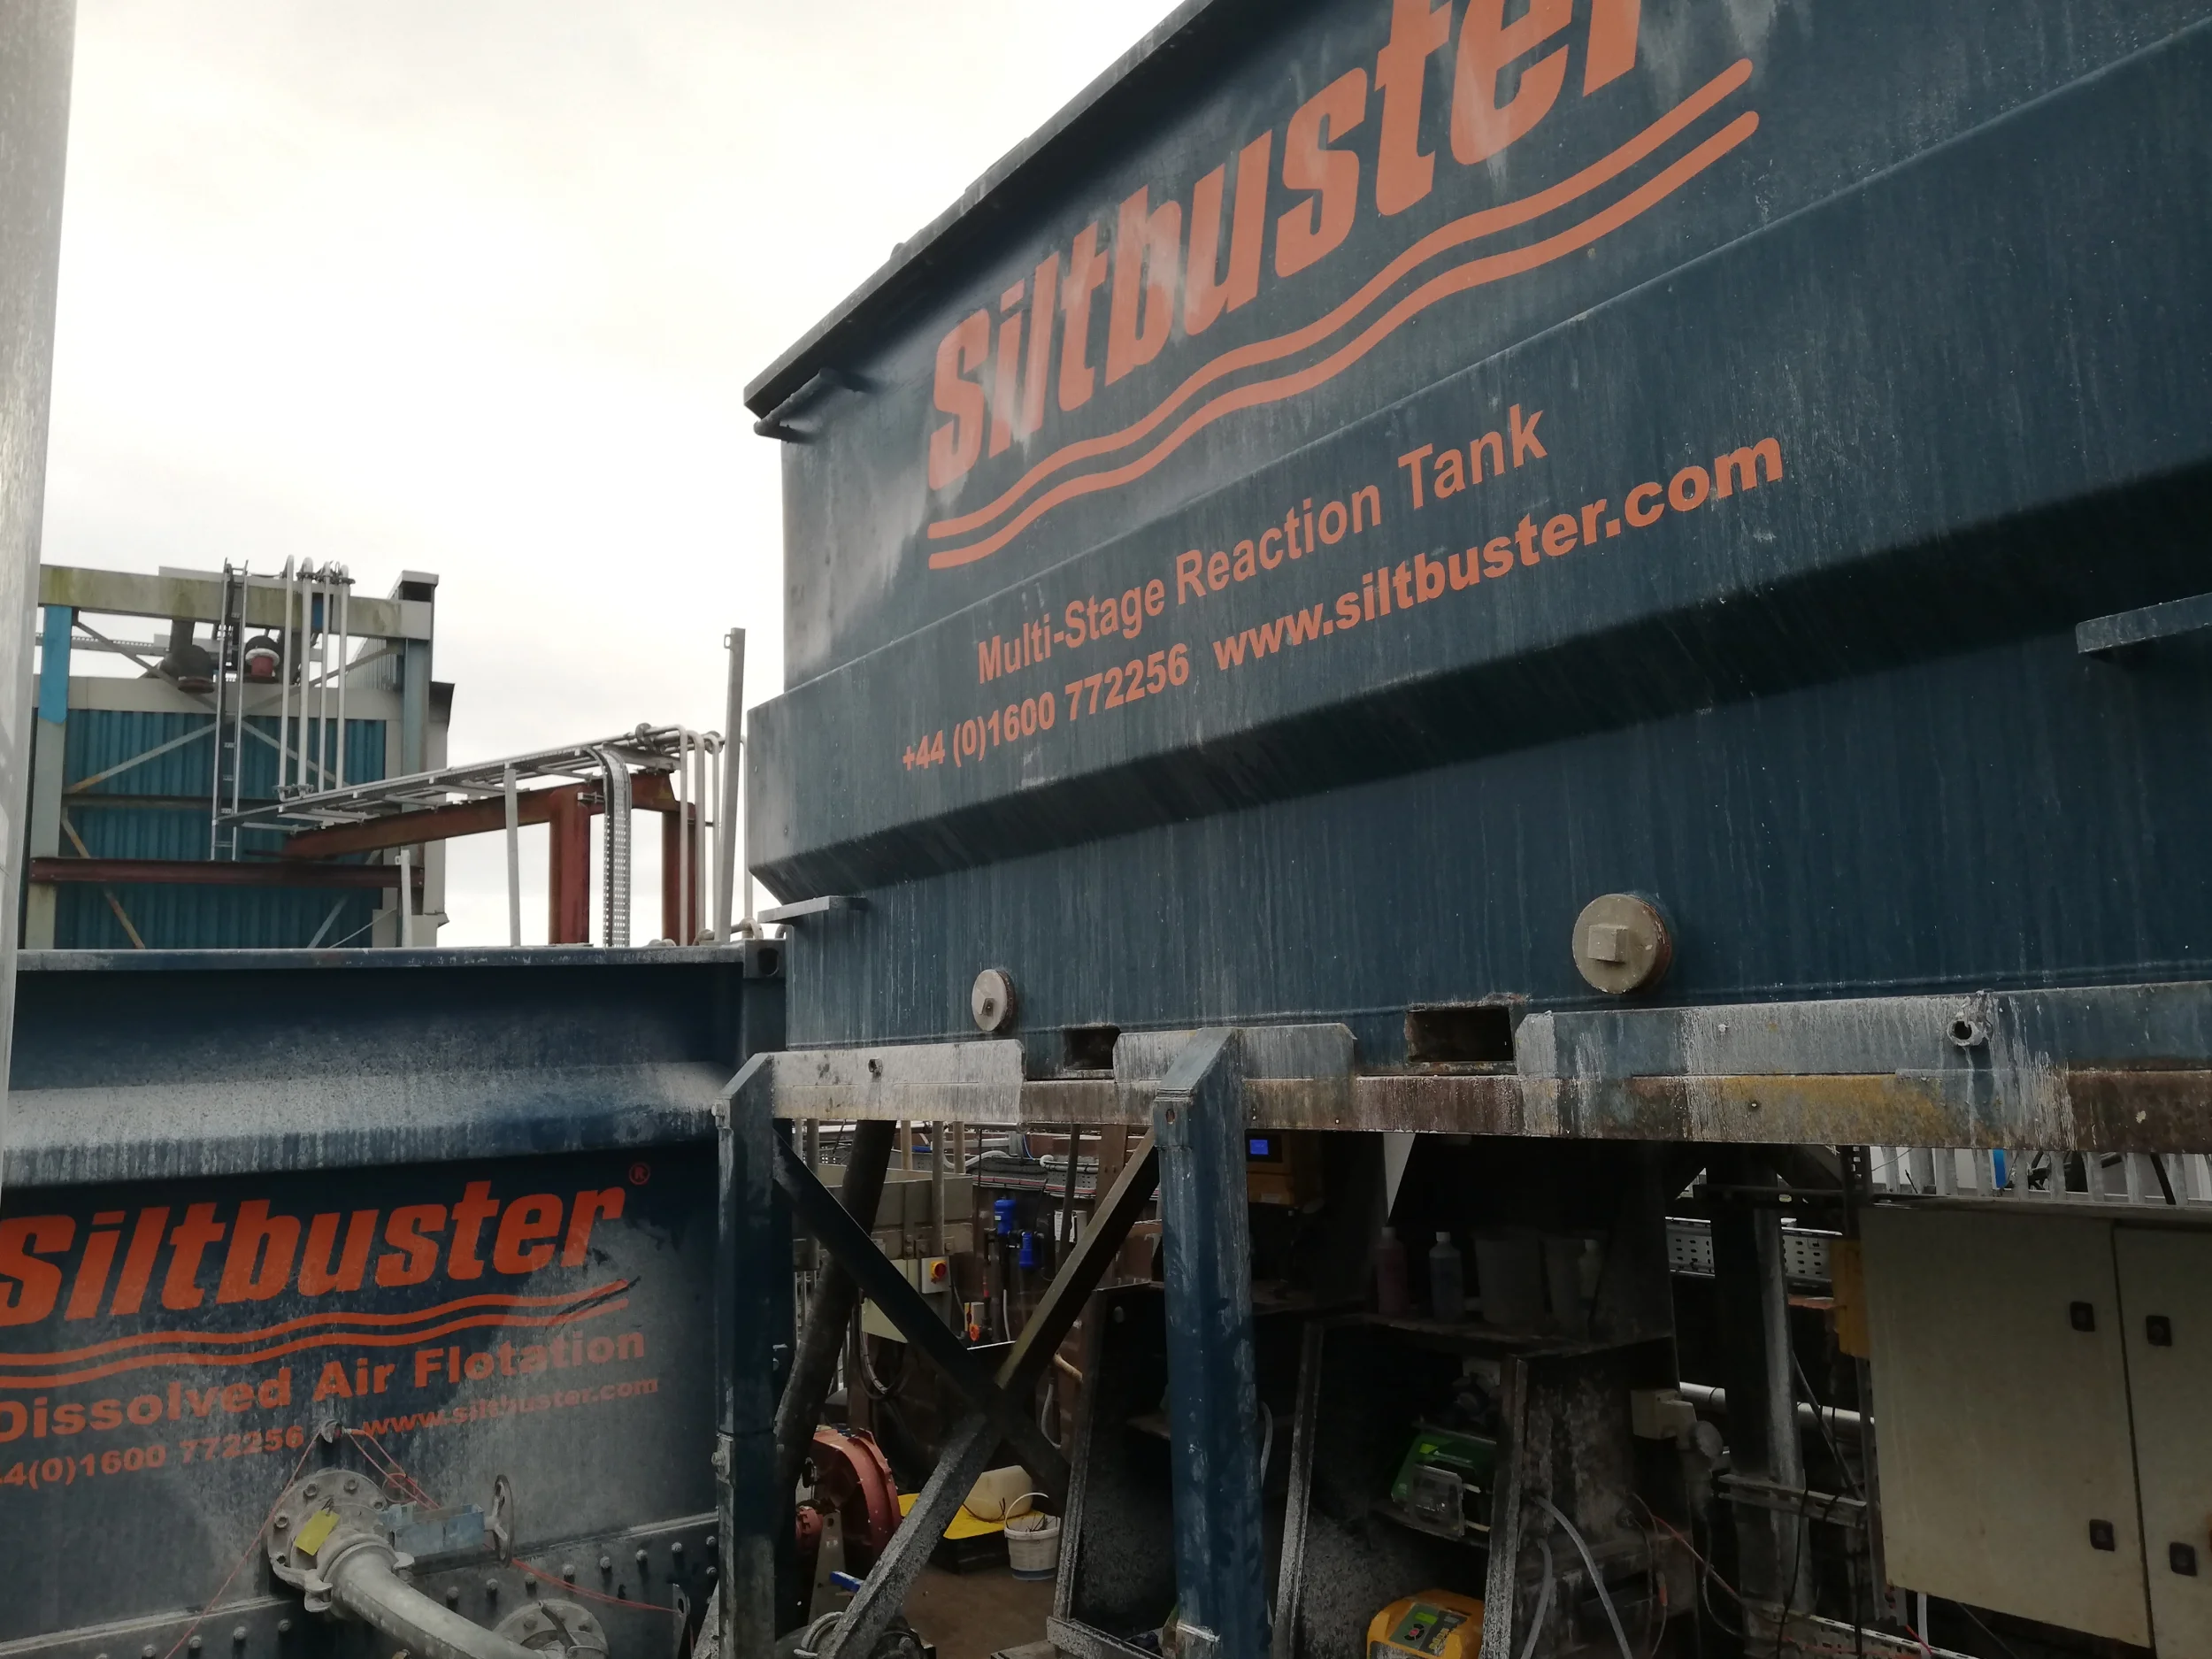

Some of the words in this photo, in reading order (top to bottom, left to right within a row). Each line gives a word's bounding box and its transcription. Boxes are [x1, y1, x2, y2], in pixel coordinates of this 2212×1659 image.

[902, 731, 945, 771] +44
[953, 692, 1055, 767] (0)1600
[1065, 643, 1189, 721] 772256
[1213, 438, 1783, 672] www.siltbuster.com
[978, 579, 1165, 684] Multi-Stage
[1177, 486, 1382, 605] Reaction
[1398, 404, 1548, 511] Tank
[0, 1181, 626, 1327] Siltbuster
[0, 1368, 292, 1443] Dissolved
[312, 1358, 396, 1402] Air
[415, 1331, 645, 1388] Flotation
[0, 1445, 166, 1490] 4(0)1600
[180, 1425, 304, 1463] 772256
[363, 1377, 658, 1436] www.siltbuster.com
